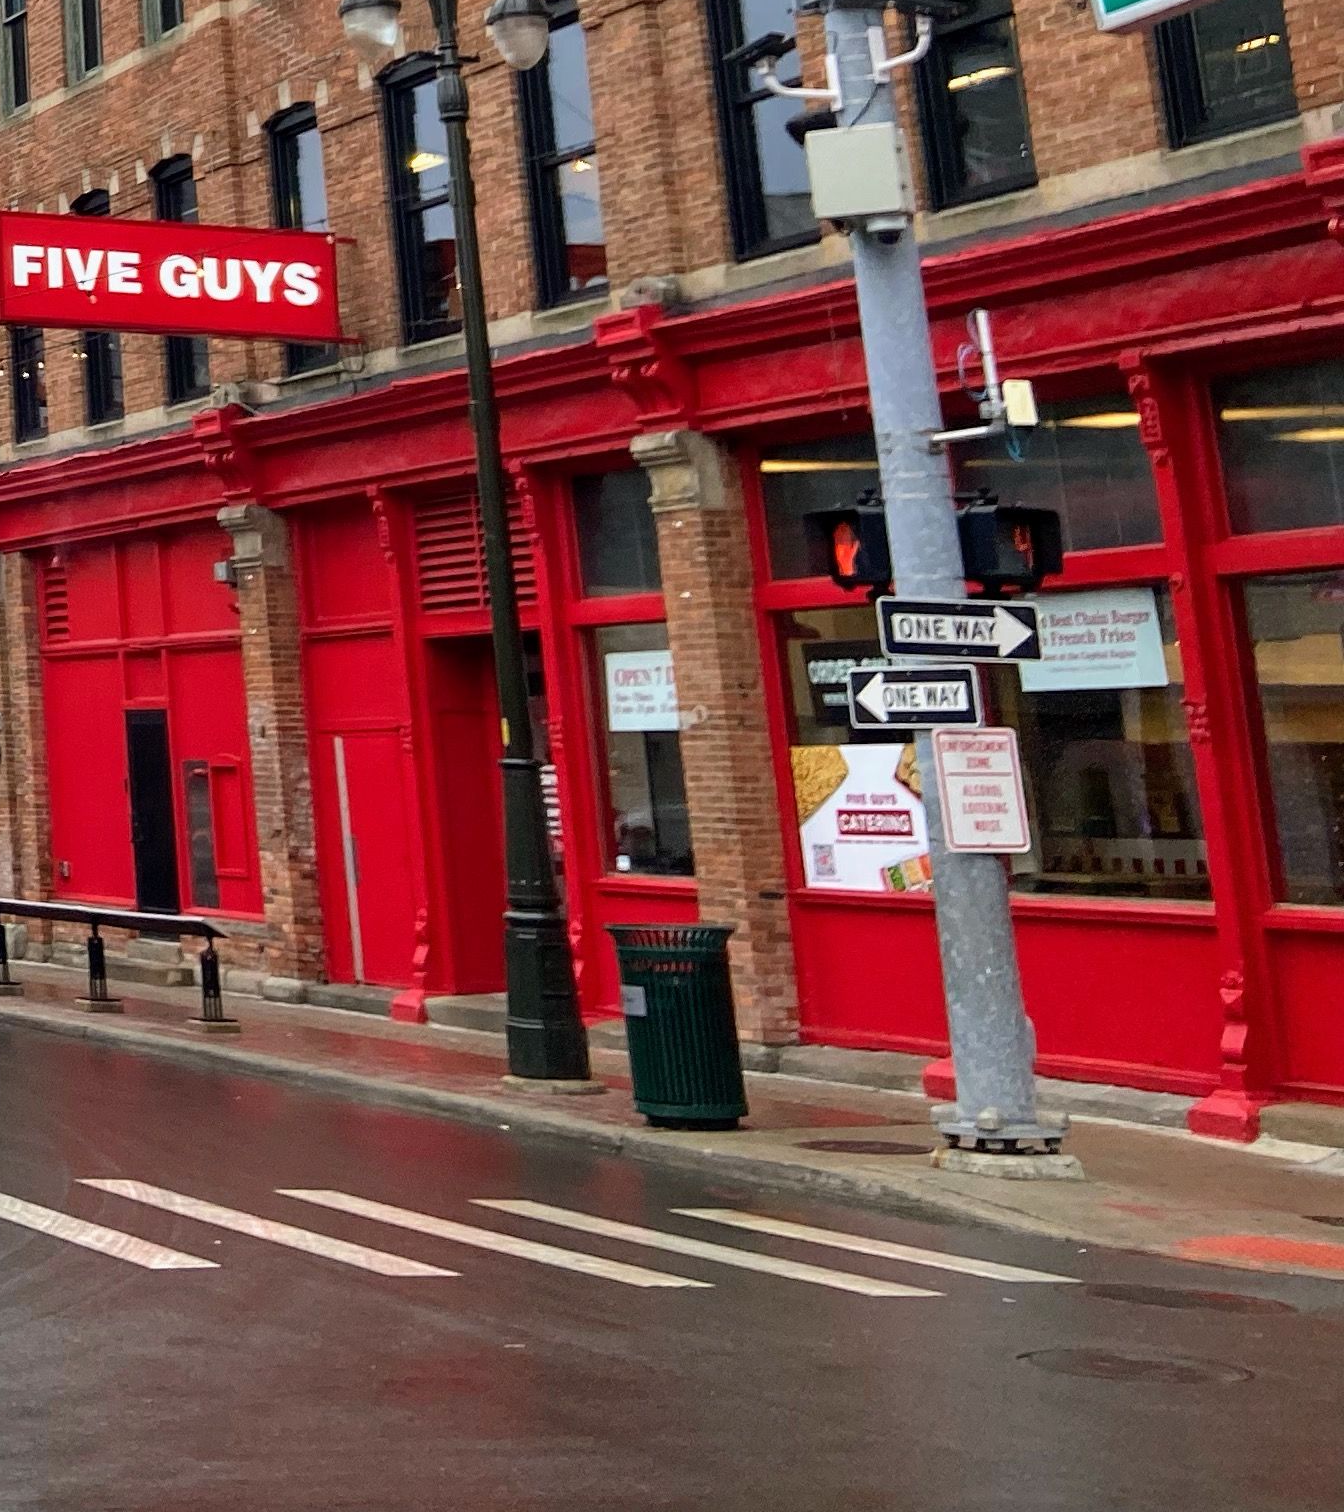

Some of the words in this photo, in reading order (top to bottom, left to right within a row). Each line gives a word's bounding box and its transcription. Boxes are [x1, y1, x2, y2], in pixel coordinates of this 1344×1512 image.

[12, 244, 143, 295] FIVE
[158, 254, 321, 307] GUYS
[898, 617, 947, 641] ONE
[952, 619, 996, 641] WAY
[882, 687, 922, 707] ONE
[923, 687, 961, 707] WAY
